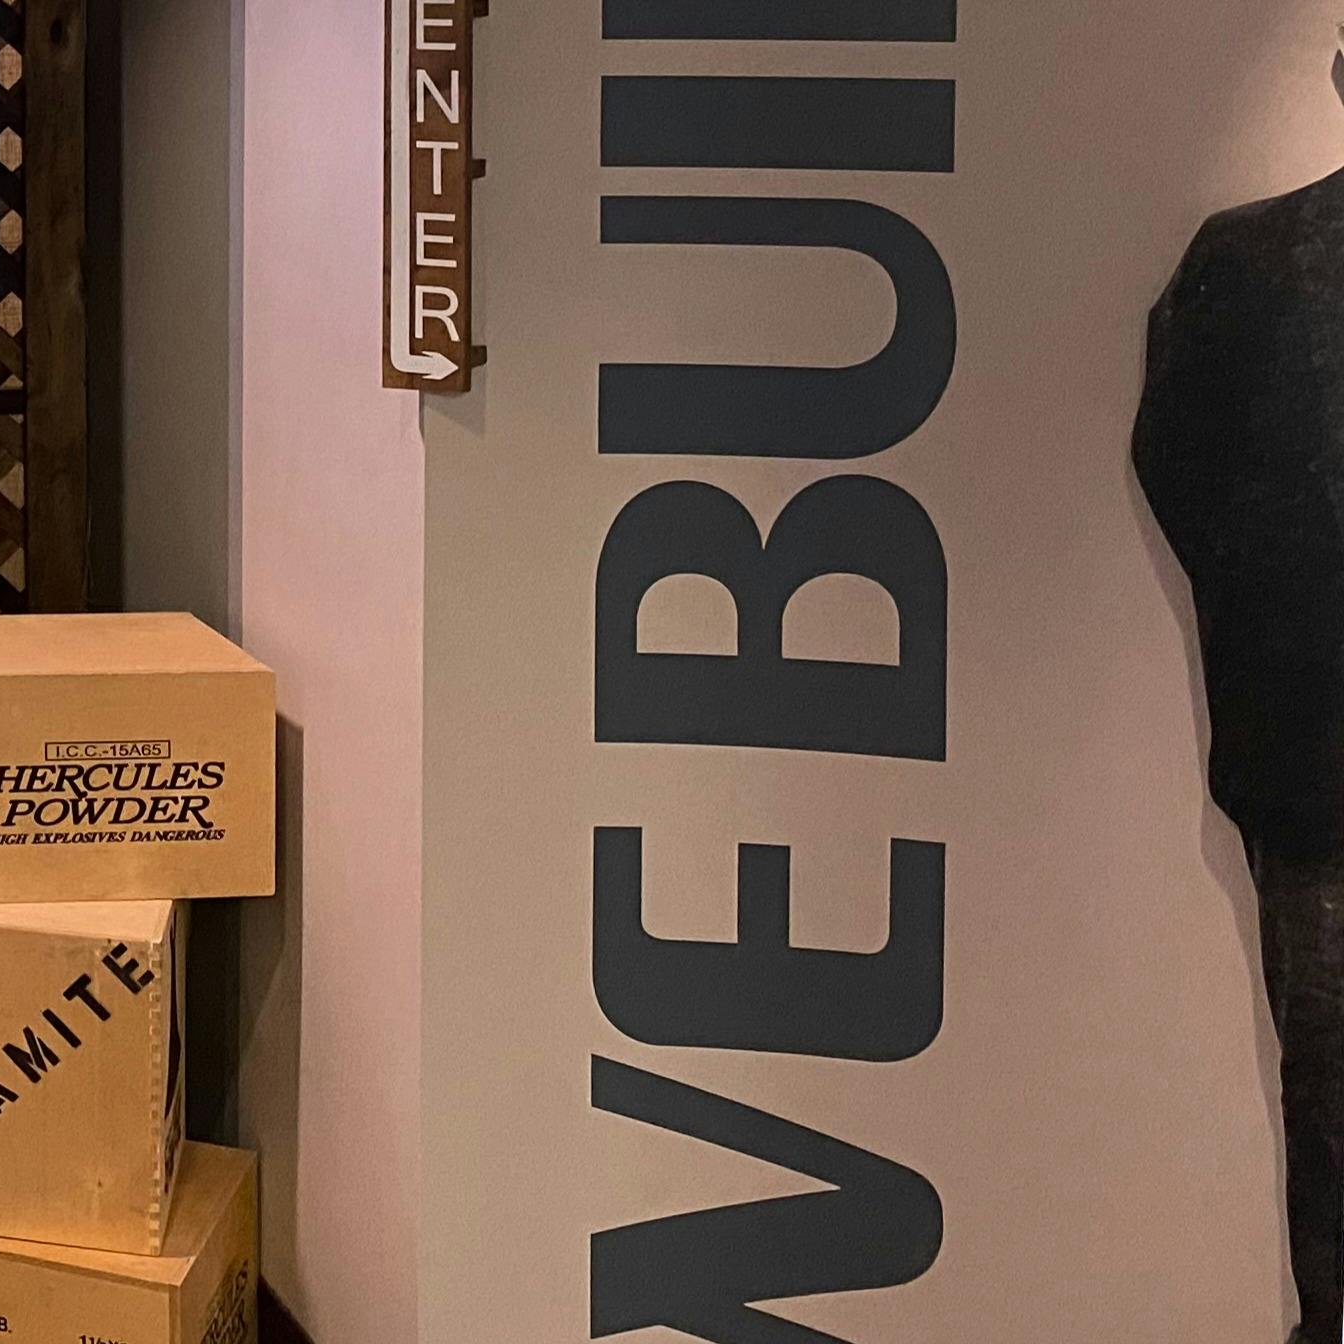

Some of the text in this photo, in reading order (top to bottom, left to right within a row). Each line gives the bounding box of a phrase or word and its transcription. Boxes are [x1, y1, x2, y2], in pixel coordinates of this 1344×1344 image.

[55, 742, 163, 759] I.C.C.-15A65
[0, 794, 214, 830] POWDER
[31, 830, 126, 845] EXPLOSIVES
[130, 828, 226, 843] DANGEROUS
